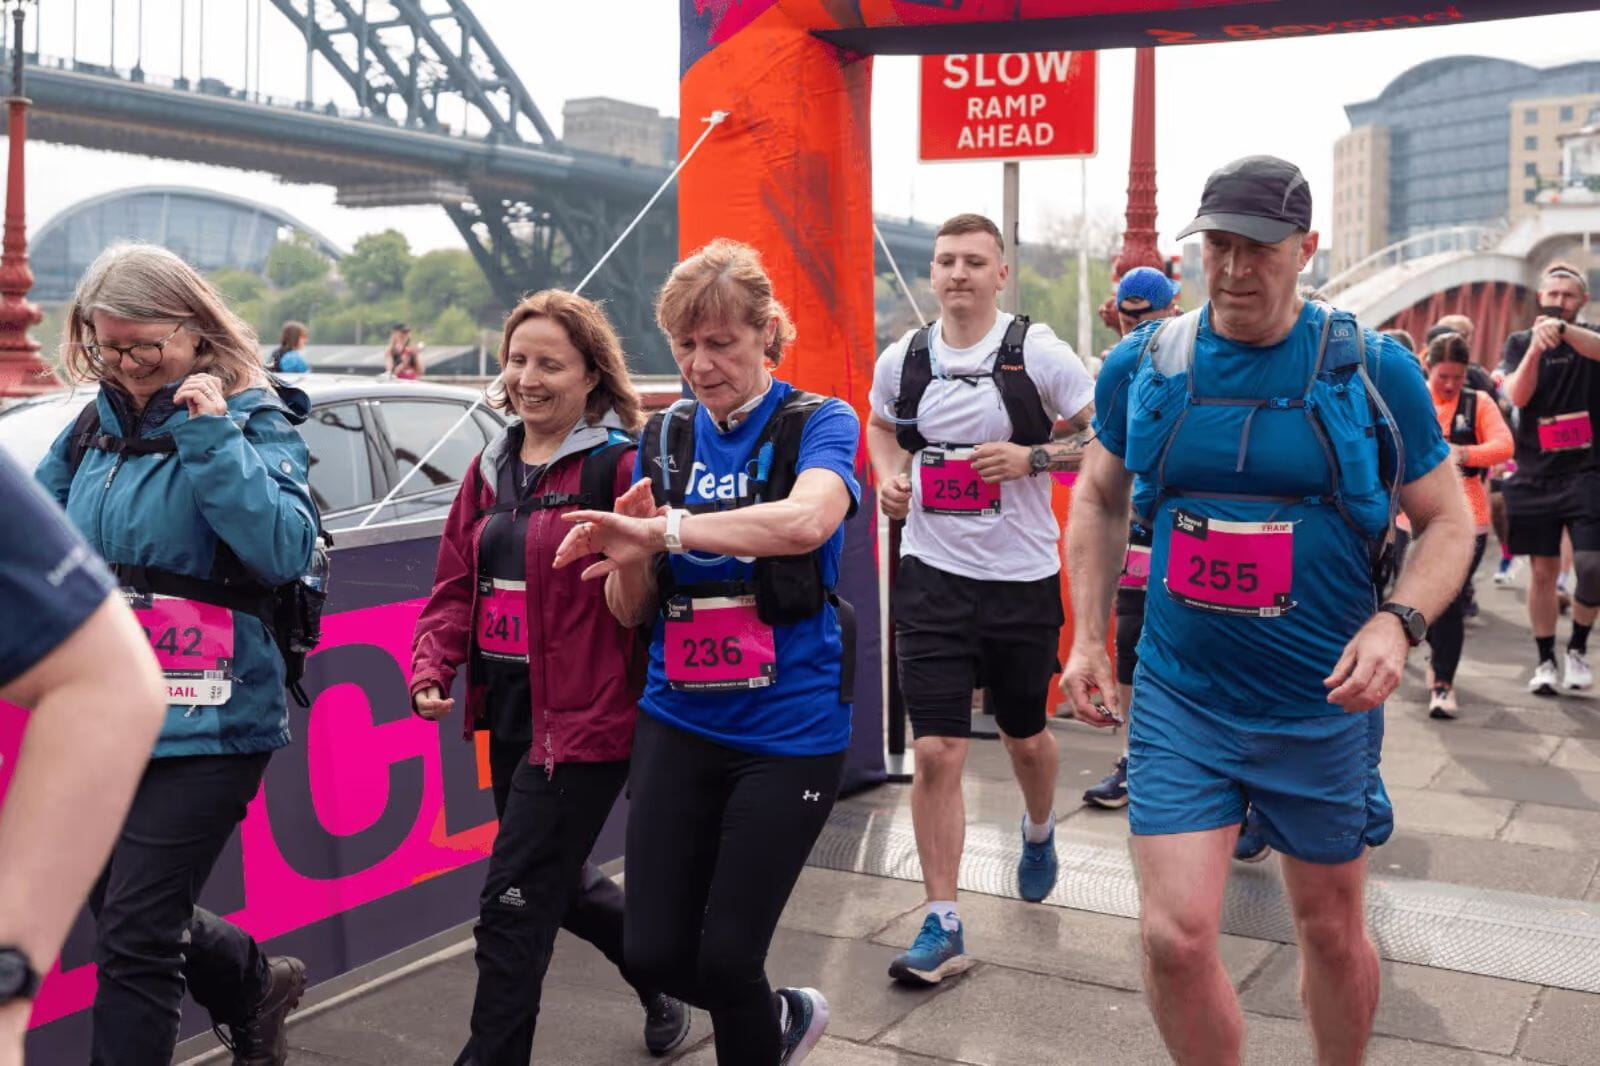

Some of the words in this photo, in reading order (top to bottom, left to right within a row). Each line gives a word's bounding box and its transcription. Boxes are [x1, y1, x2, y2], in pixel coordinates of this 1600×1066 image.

[943, 52, 1072, 89] SLOW
[967, 94, 1047, 119] RAMP
[957, 123, 1054, 149] AHEAD
[934, 480, 980, 501] 254
[1187, 554, 1259, 593] 255
[485, 611, 521, 642] 241
[143, 627, 204, 657] 42
[683, 635, 743, 668] 236
[166, 687, 198, 698] RAIL
